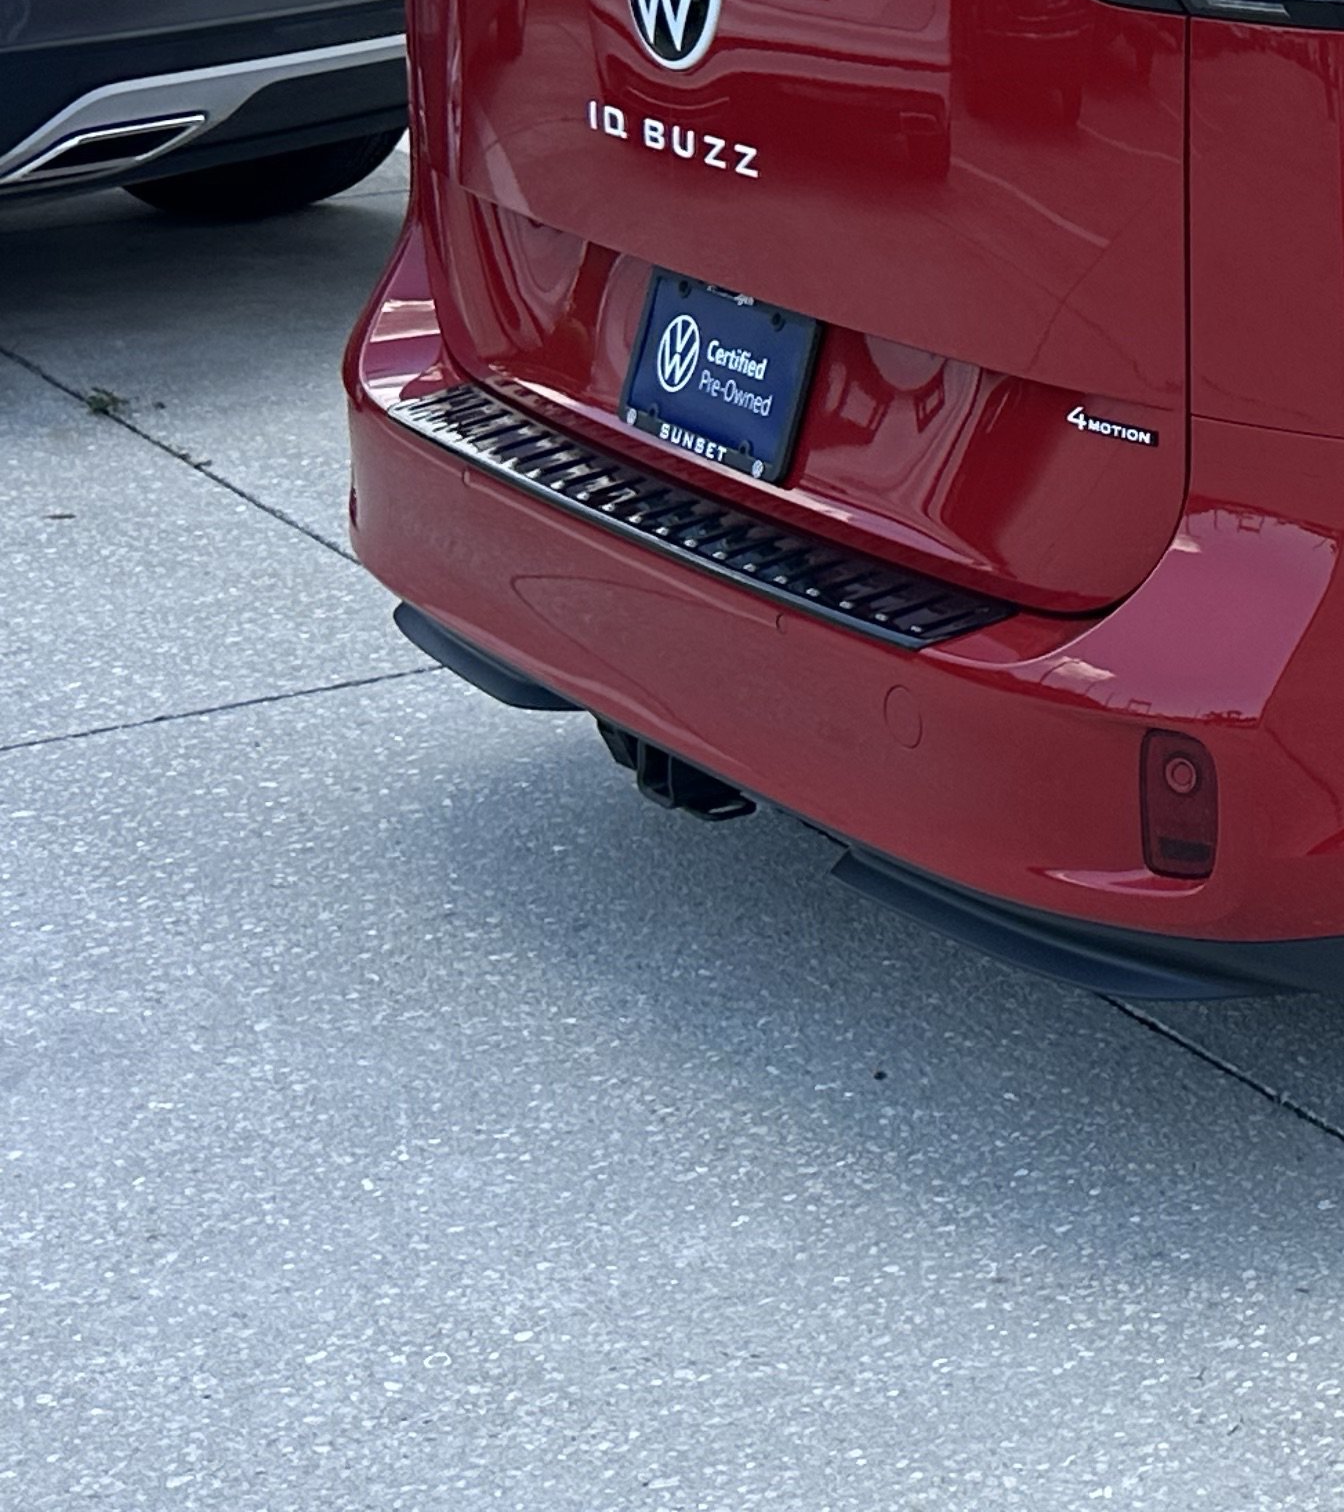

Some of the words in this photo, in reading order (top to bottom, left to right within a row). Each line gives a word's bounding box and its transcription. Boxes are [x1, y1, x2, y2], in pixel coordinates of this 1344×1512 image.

[643, 117, 759, 178] BUZZ
[706, 339, 768, 381] Certified
[698, 369, 773, 417] Pre-Owned
[659, 422, 728, 463] SUNSET
[1066, 406, 1151, 444] 4MOTION
